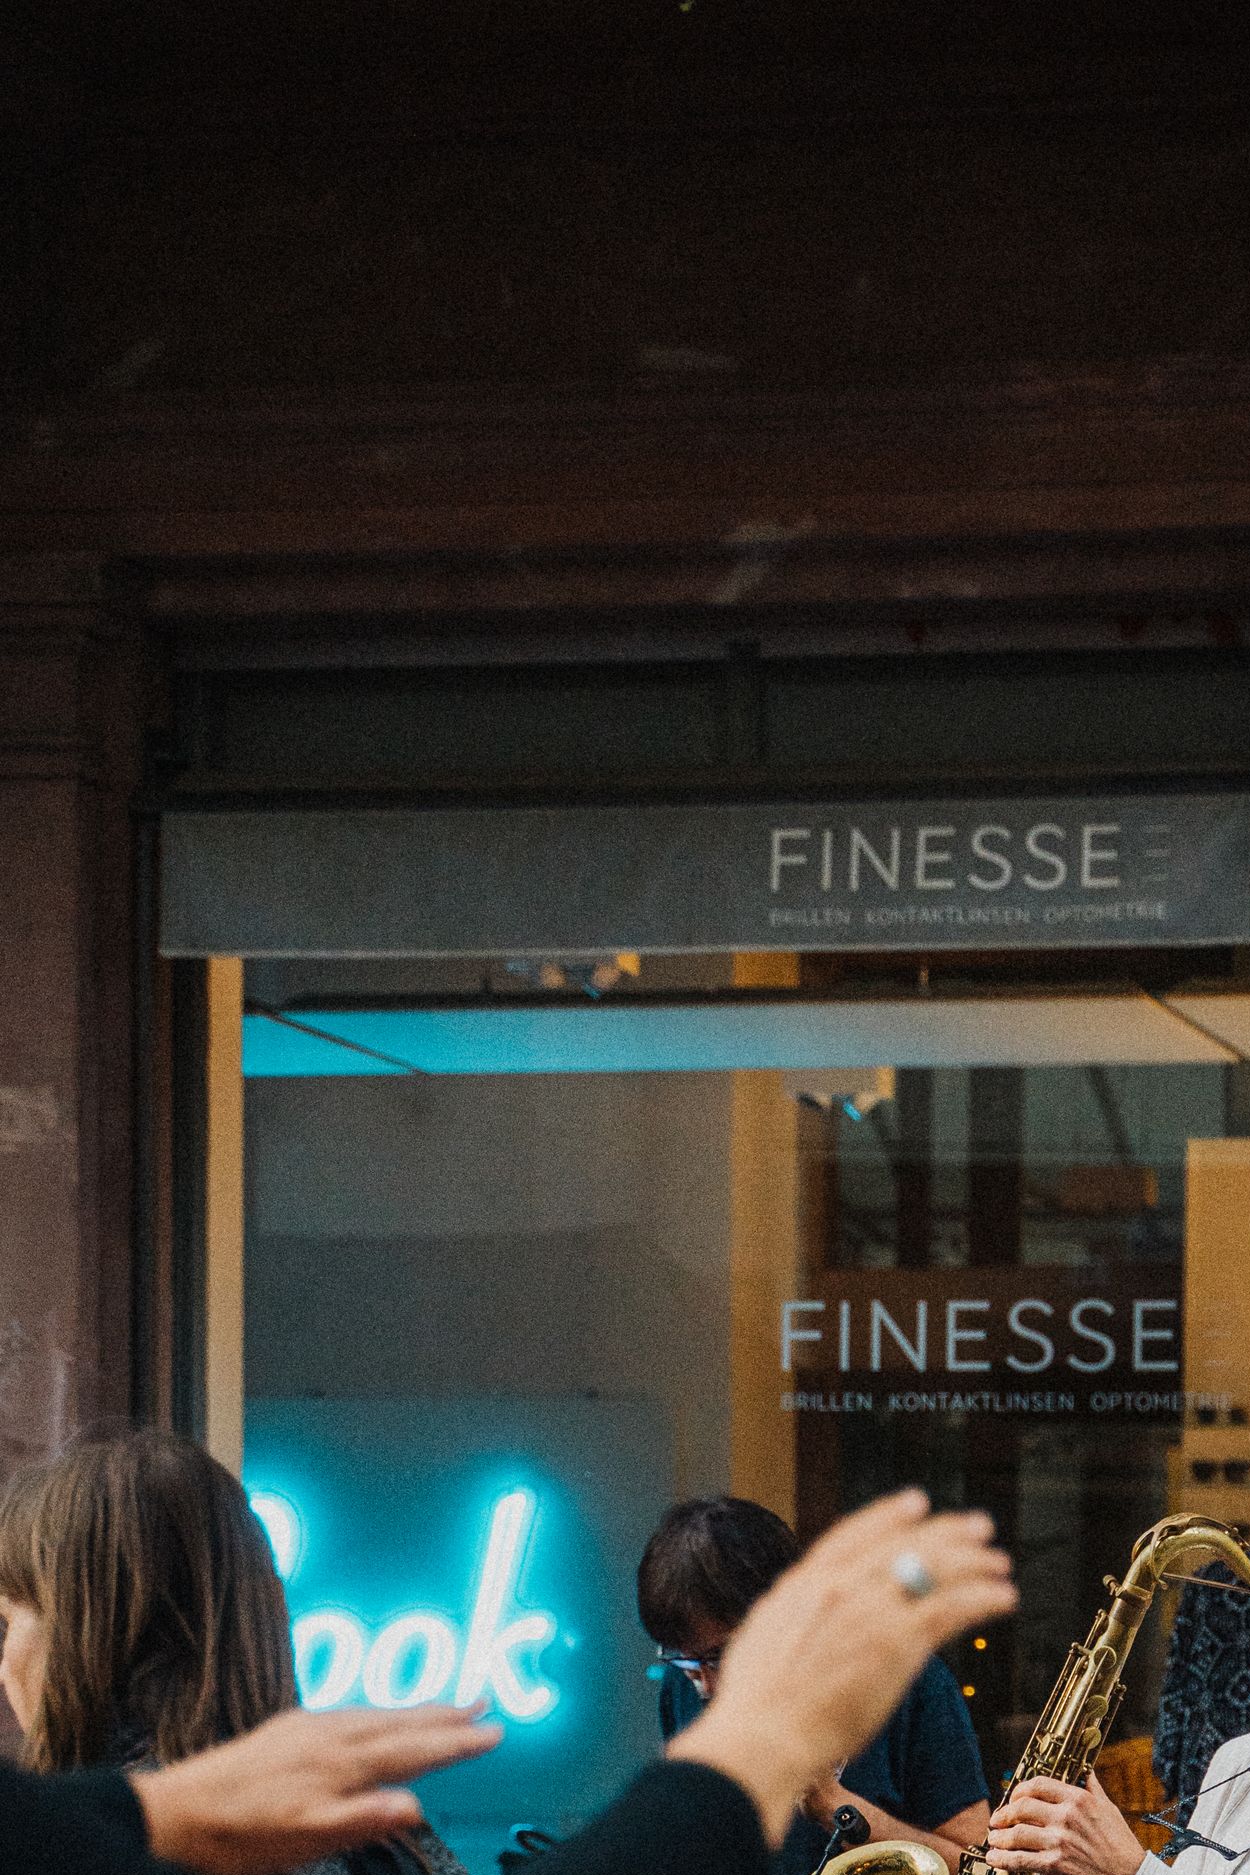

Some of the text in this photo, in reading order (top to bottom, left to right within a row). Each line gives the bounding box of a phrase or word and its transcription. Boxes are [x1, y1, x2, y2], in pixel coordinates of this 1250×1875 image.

[772, 823, 1122, 892] FINESSE
[780, 1299, 1179, 1373] FINESSE
[780, 1391, 1232, 1412] BRILLEN KONTAKTLINSEN OPTOMETRIE
[249, 1485, 557, 1720] ook
